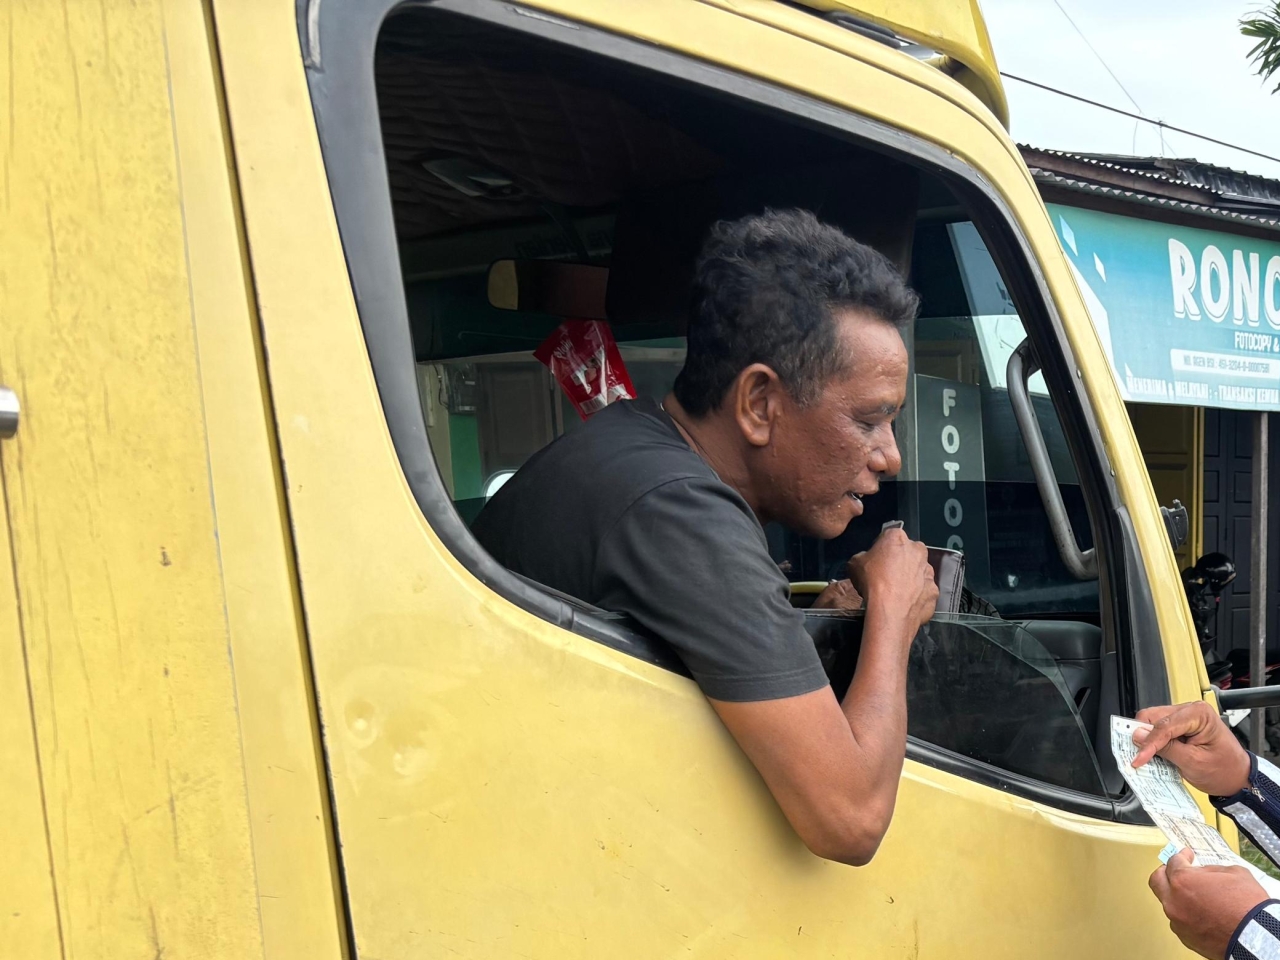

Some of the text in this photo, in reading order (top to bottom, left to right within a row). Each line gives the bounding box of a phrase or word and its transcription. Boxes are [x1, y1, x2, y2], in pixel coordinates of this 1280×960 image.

[1234, 331, 1272, 352] FOTOCOPY
[1273, 338, 1280, 352] &
[1219, 385, 1256, 403] TRANSAKSI
